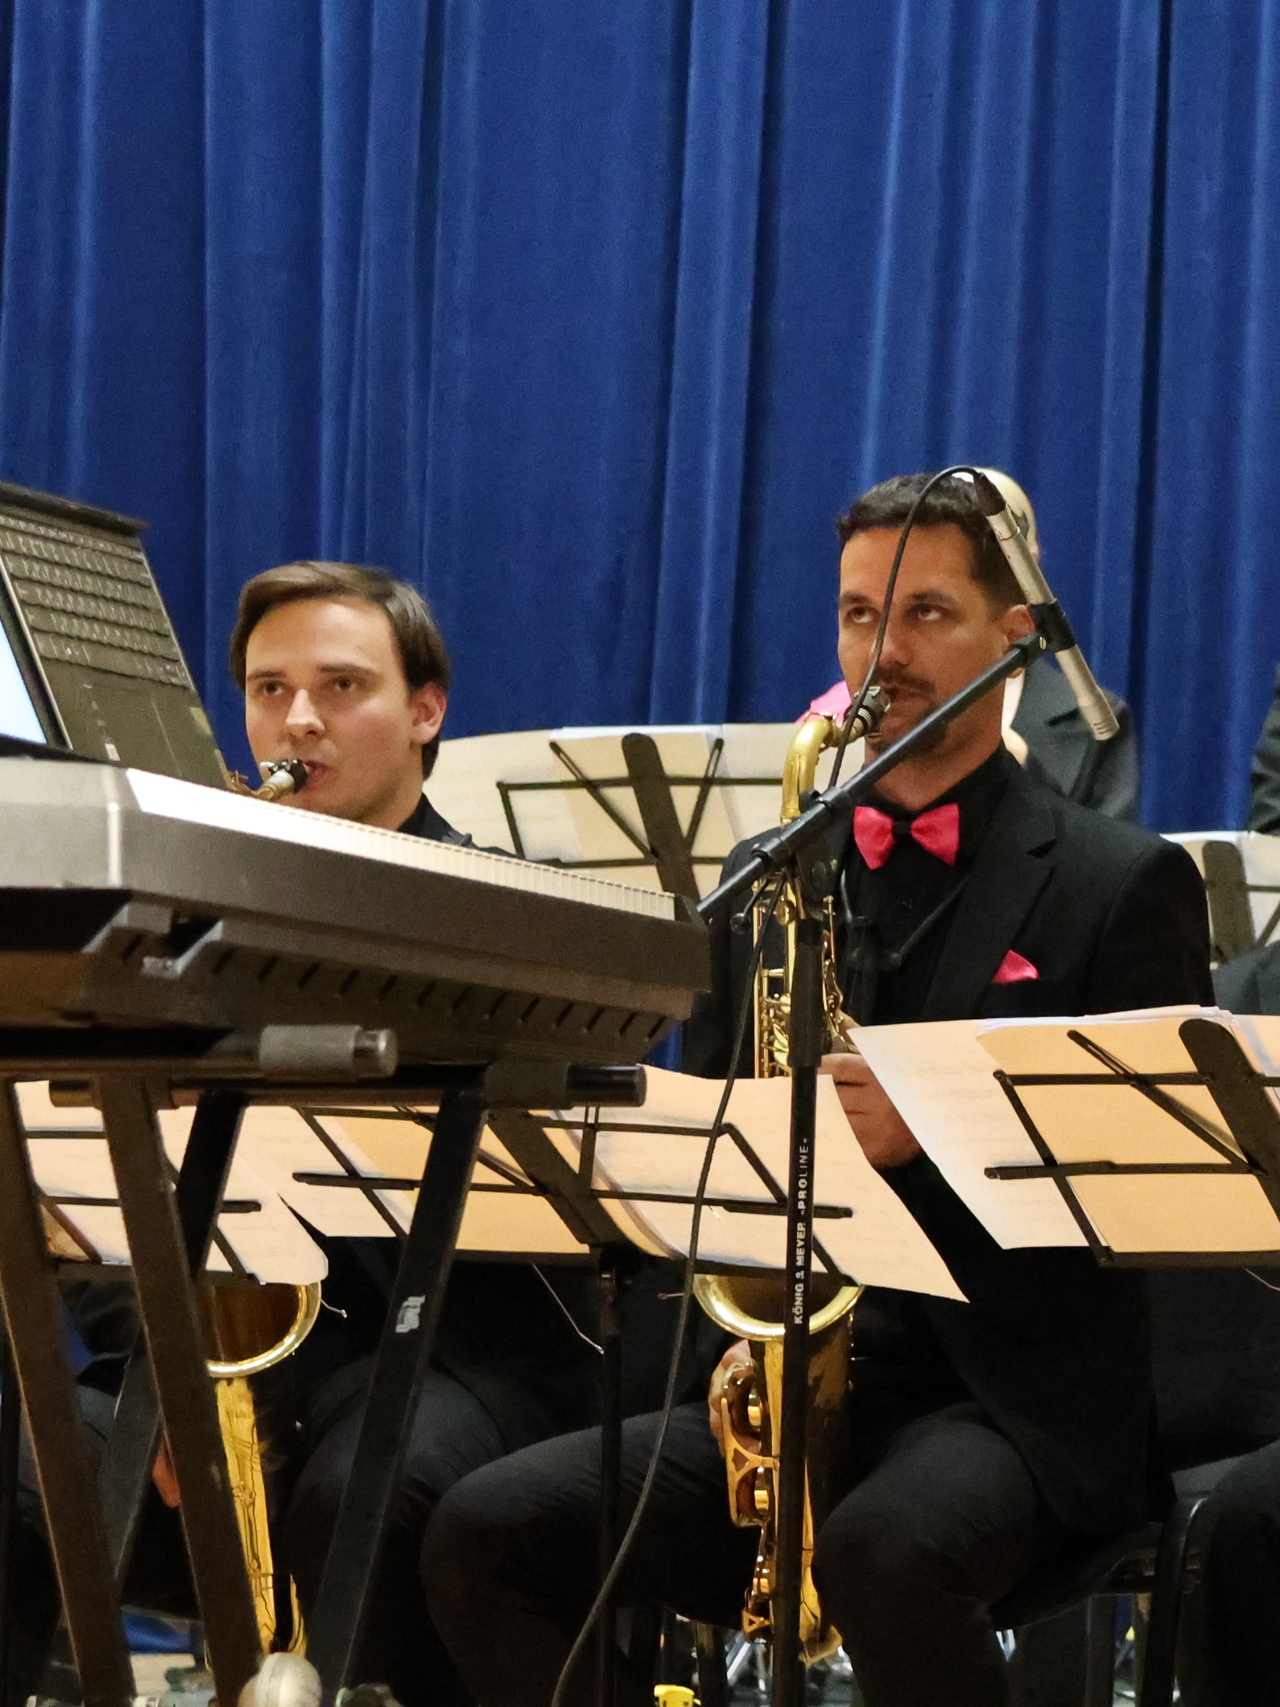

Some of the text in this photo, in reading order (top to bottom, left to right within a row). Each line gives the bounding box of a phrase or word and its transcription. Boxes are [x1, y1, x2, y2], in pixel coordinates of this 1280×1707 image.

[796, 1222, 806, 1267] MEYER
[796, 1270, 805, 1280] &
[792, 1283, 804, 1324] KÖNIG
